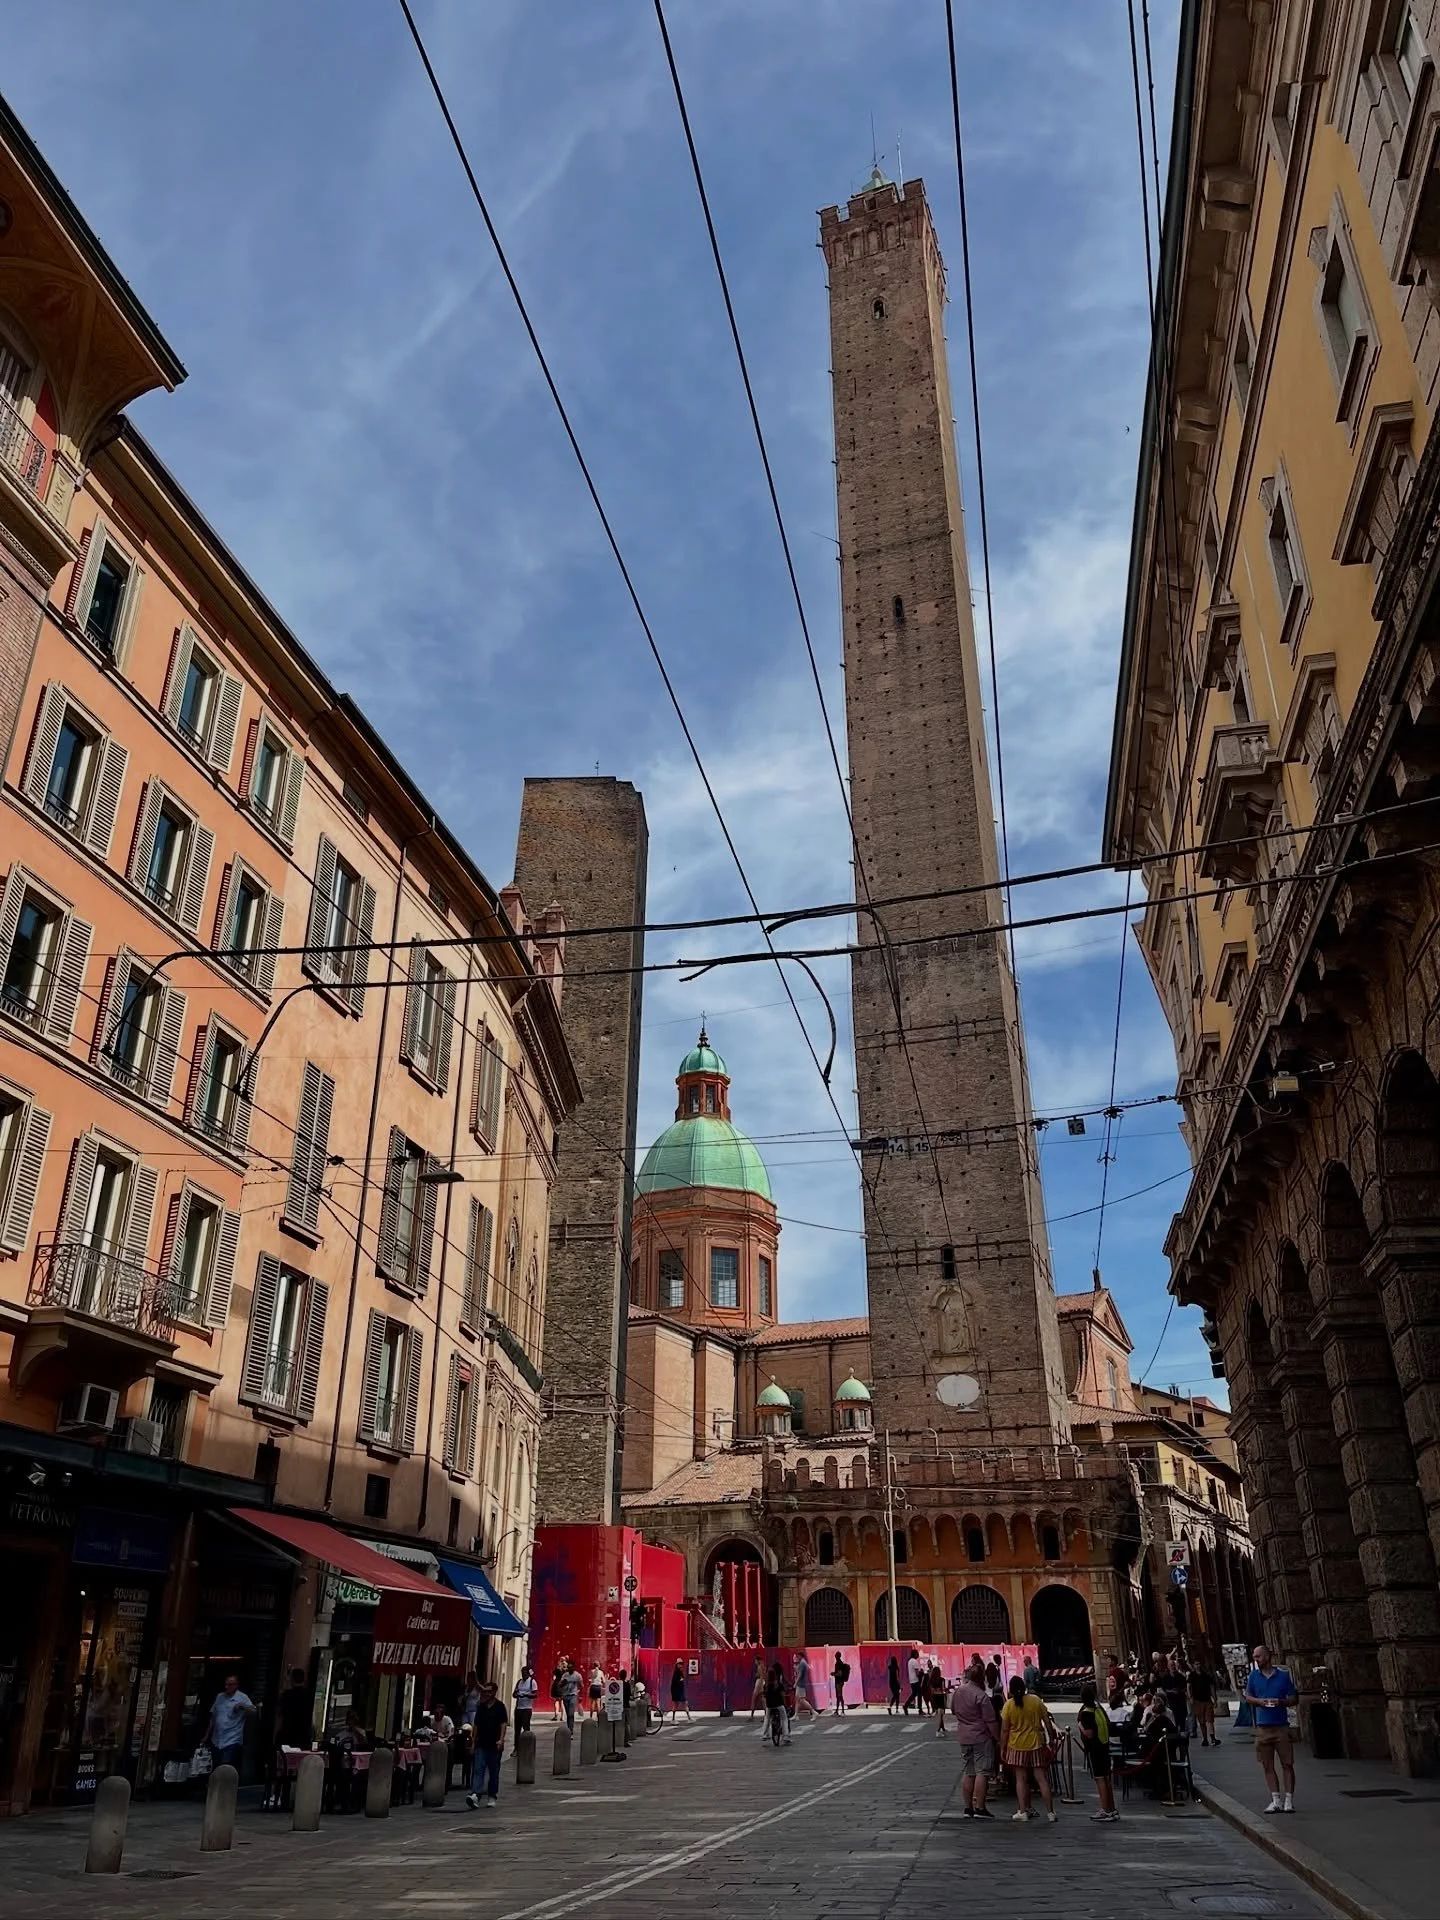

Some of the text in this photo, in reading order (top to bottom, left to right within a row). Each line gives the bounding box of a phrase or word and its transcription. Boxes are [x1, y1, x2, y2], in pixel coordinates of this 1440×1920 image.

[1070, 1122, 1084, 1133] 13
[889, 1142, 929, 1153] 14 15
[75, 1779, 97, 1790] GAMES
